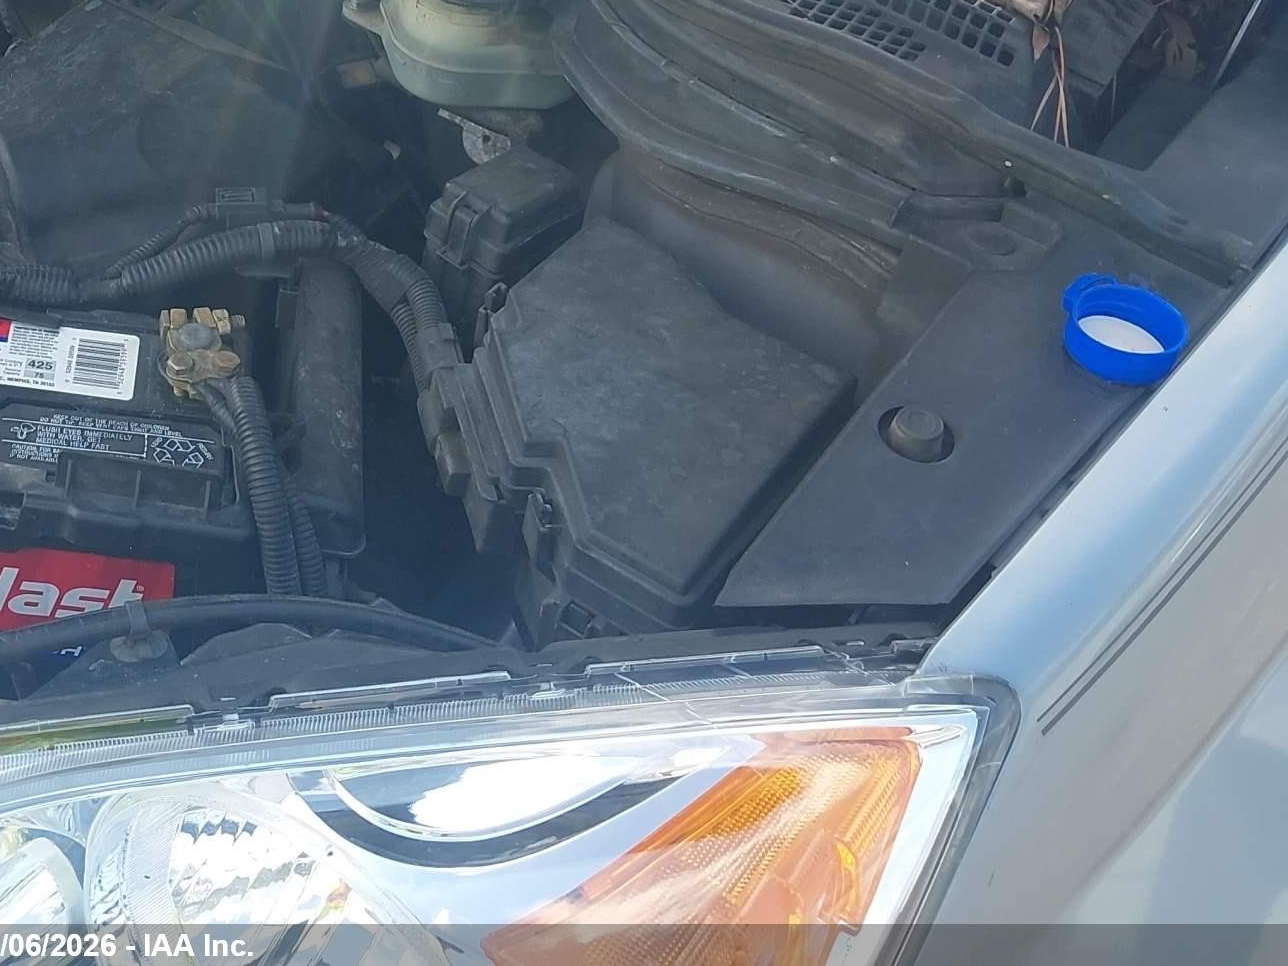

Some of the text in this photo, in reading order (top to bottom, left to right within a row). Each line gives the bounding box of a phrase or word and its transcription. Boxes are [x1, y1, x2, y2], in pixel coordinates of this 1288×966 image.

[27, 359, 53, 371] 425
[37, 424, 61, 434] FLUSH
[84, 430, 132, 442] IMMEDIATELY
[37, 430, 56, 439] WITH
[36, 437, 110, 451] MEDICAL HELP FAST
